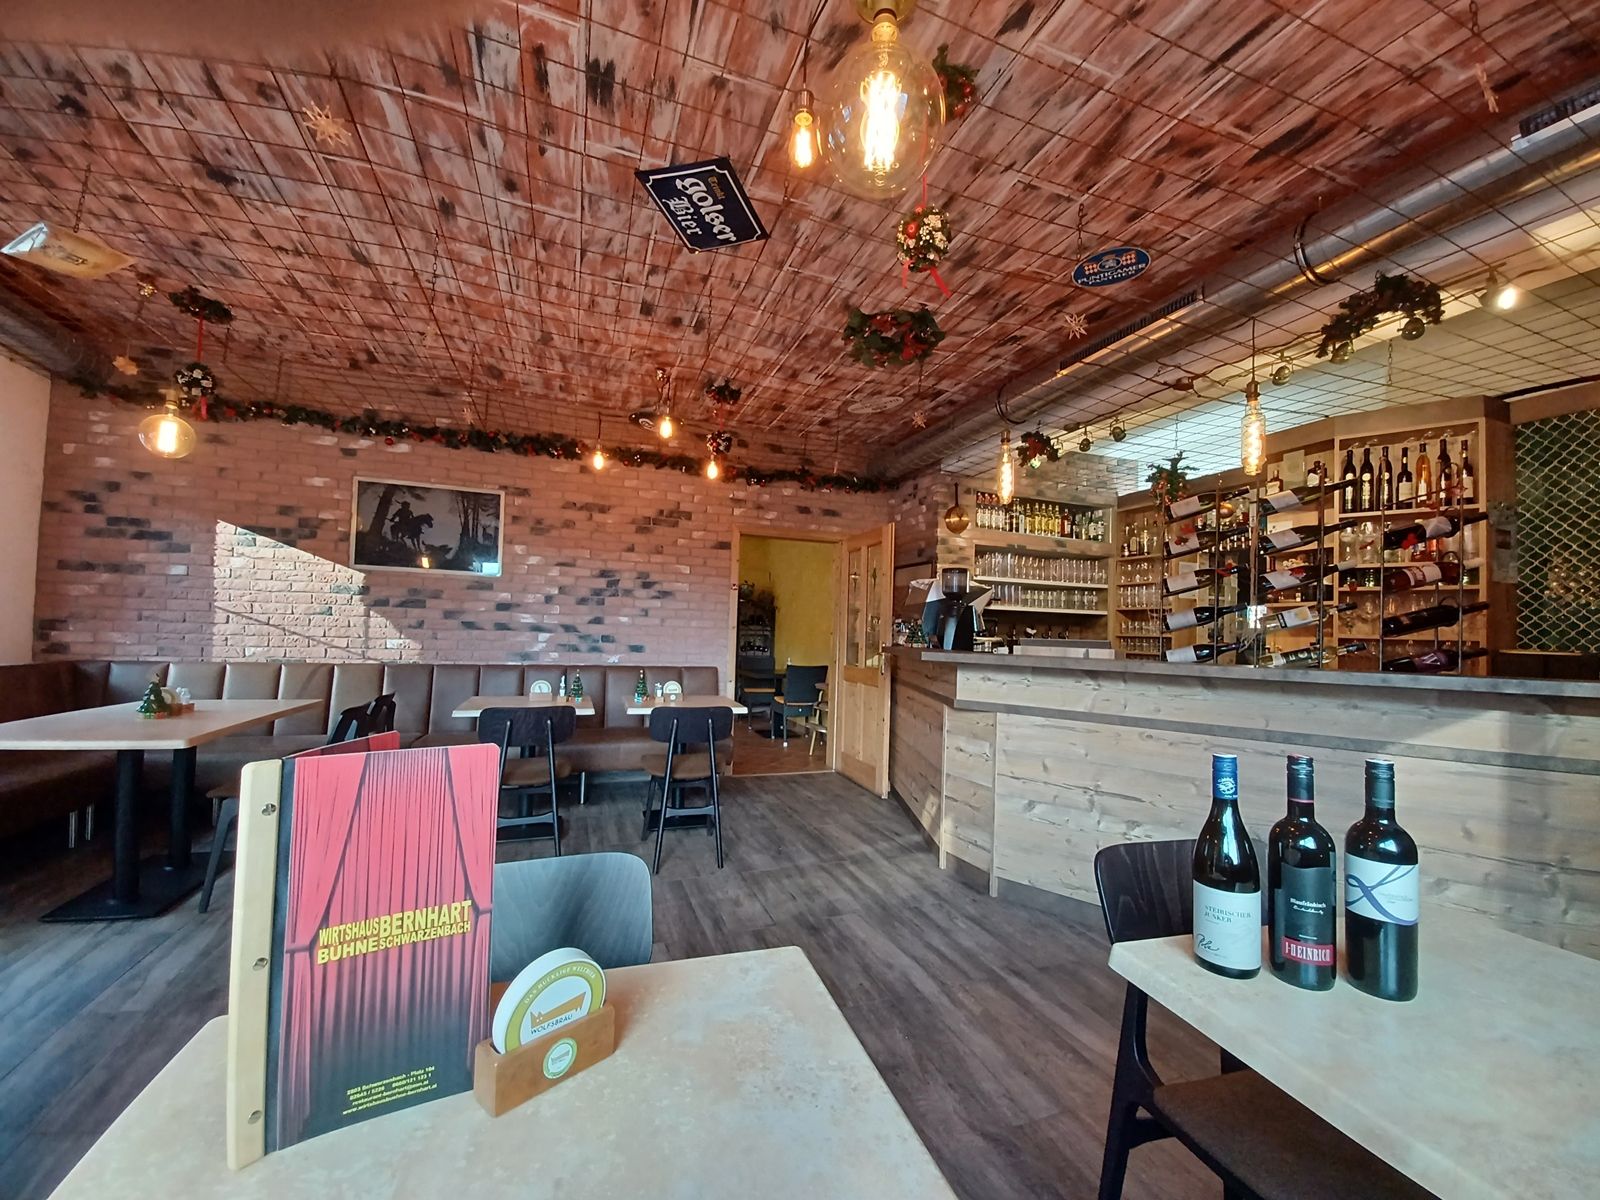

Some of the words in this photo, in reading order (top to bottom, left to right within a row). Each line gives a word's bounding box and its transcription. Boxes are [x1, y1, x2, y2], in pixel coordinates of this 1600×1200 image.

[661, 196, 703, 235] Bier
[317, 937, 379, 965] BÜHNE
[379, 921, 471, 950] SCHWARZENBACH
[319, 917, 380, 947] WIRTSHAUS
[380, 900, 472, 938] BERNHART
